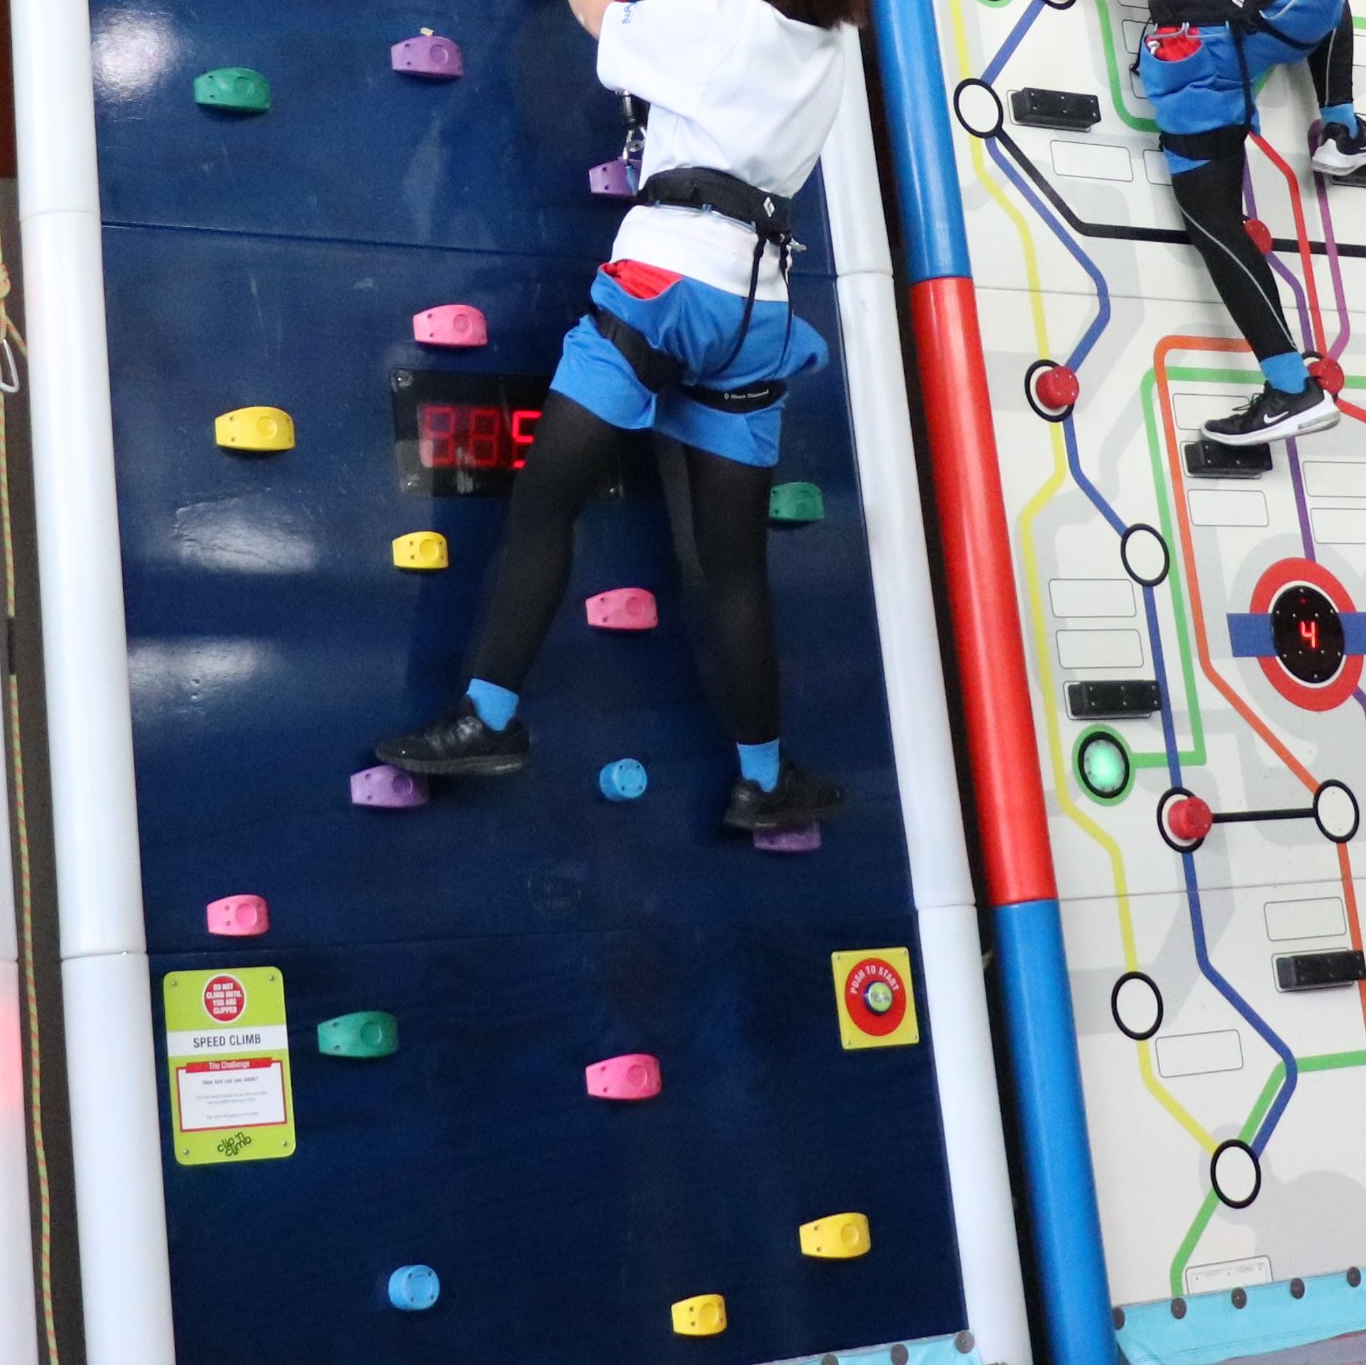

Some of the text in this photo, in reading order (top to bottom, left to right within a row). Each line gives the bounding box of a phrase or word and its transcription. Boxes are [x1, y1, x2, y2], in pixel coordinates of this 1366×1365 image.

[1299, 620, 1318, 650] 4
[850, 964, 900, 995] PUSH TO START
[193, 1033, 262, 1049] SPEED CLIMB
